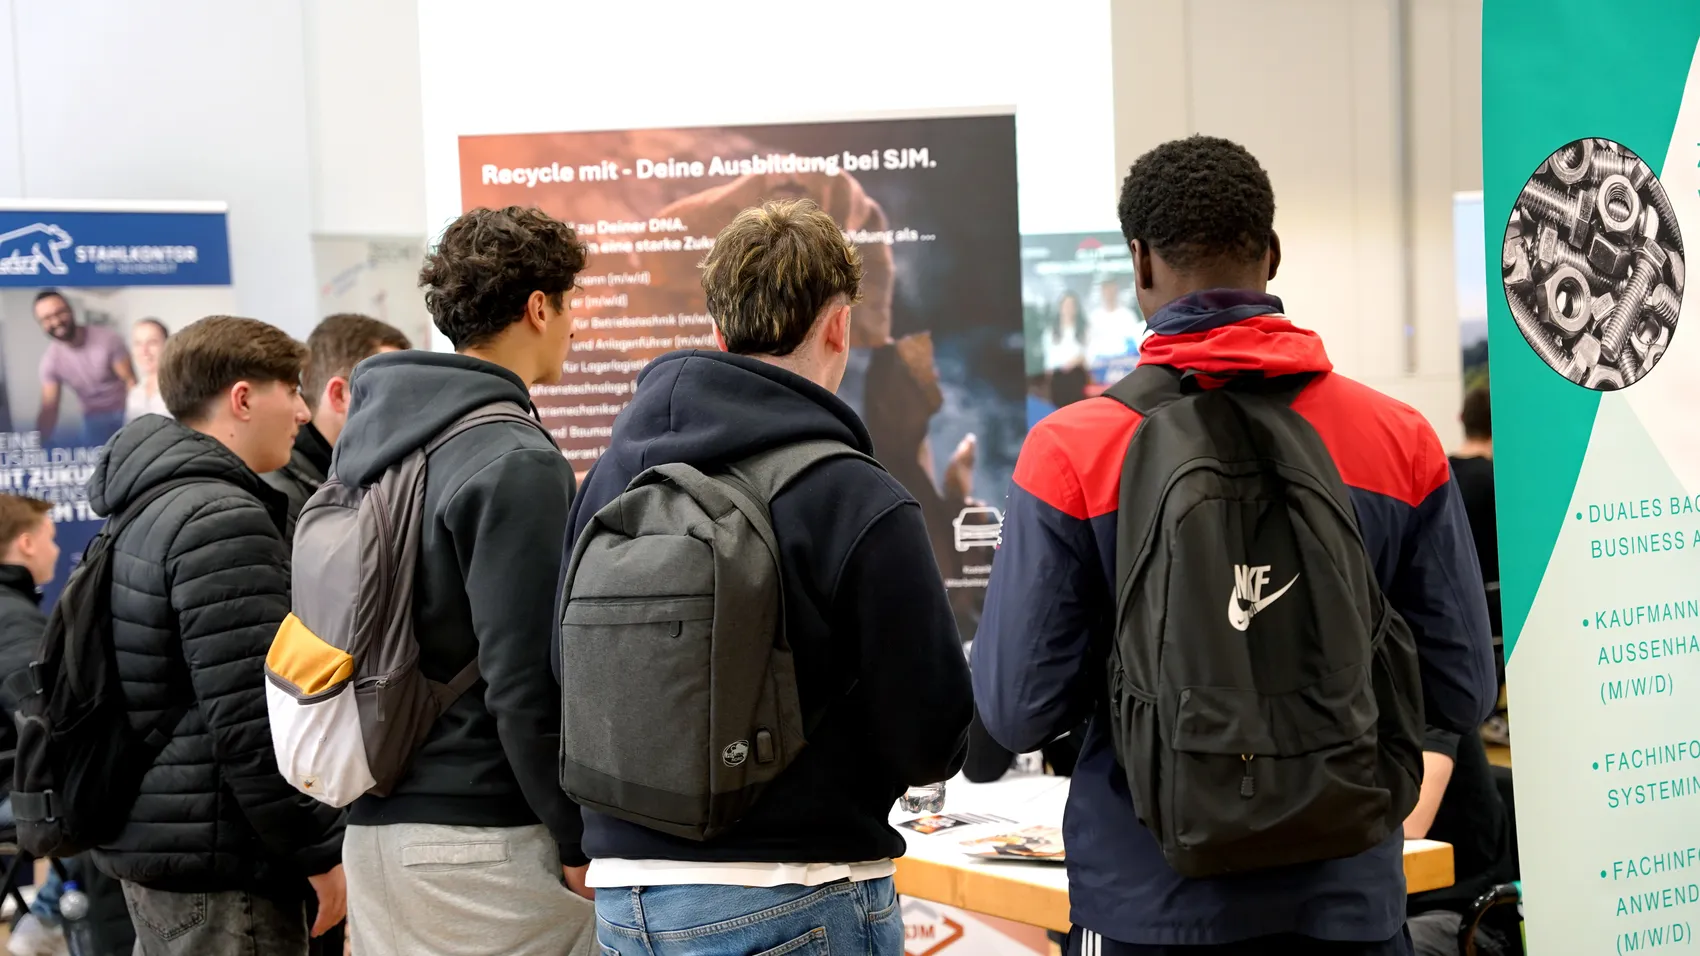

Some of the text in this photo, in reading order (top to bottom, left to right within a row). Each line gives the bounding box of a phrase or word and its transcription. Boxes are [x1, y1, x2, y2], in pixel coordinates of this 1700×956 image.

[481, 162, 574, 188] Recycle
[579, 160, 619, 181] mit
[636, 157, 704, 179] Deine
[708, 153, 840, 177] Ausbildung
[843, 150, 880, 171] bei
[883, 147, 937, 170] SJM.
[597, 219, 647, 234] Deiner
[649, 217, 688, 232] DNA.
[600, 240, 633, 252] eine
[635, 237, 682, 252] starke
[895, 226, 919, 242] als
[75, 245, 198, 263] STAHLKONTOR
[607, 271, 651, 286] (m/w/d)
[573, 316, 589, 329] für
[591, 315, 676, 329] Betriebstechnik
[571, 339, 594, 351] und
[595, 335, 673, 352] Anlagenführer
[562, 360, 579, 373] für
[1588, 498, 1663, 523] DUALES
[1591, 531, 1685, 559] BUSINESS
[1595, 599, 1699, 630] KAUFMANN
[1598, 634, 1700, 666] AUSSENHA
[1600, 673, 1673, 706] (M/W/D)
[1605, 740, 1700, 773] FACHINFO
[1613, 847, 1700, 881] FACHINF
[1616, 883, 1700, 917] ANWEND
[1617, 922, 1691, 956] (M/W/D)
